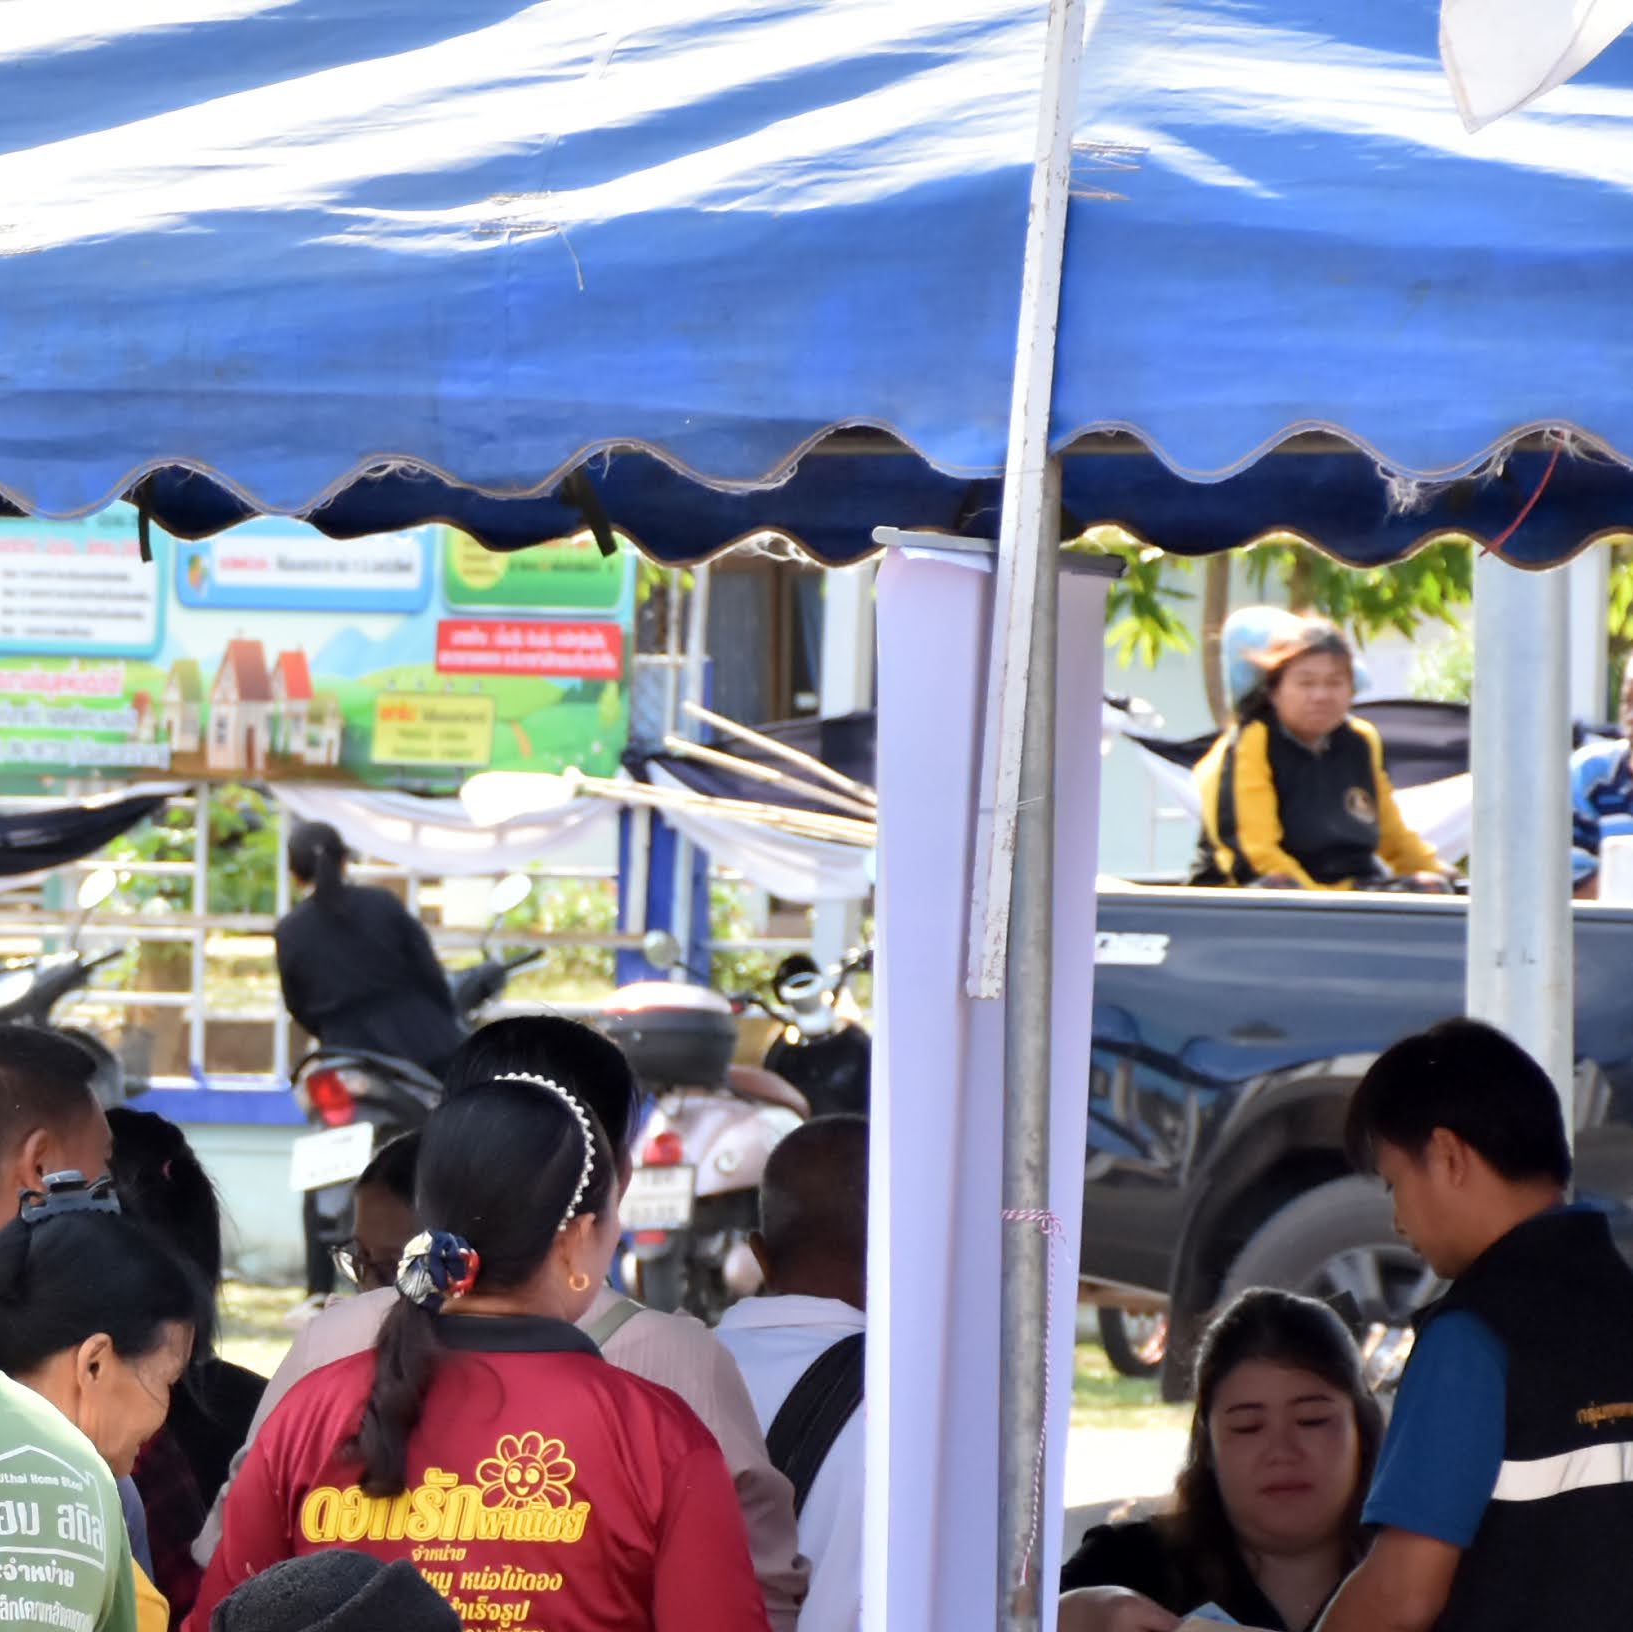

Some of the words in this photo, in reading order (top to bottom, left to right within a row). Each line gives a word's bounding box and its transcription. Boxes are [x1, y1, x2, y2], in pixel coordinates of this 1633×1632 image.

[411, 1546, 467, 1562] จำหน่าย
[459, 1564, 564, 1592] หน่อไม้ดอง
